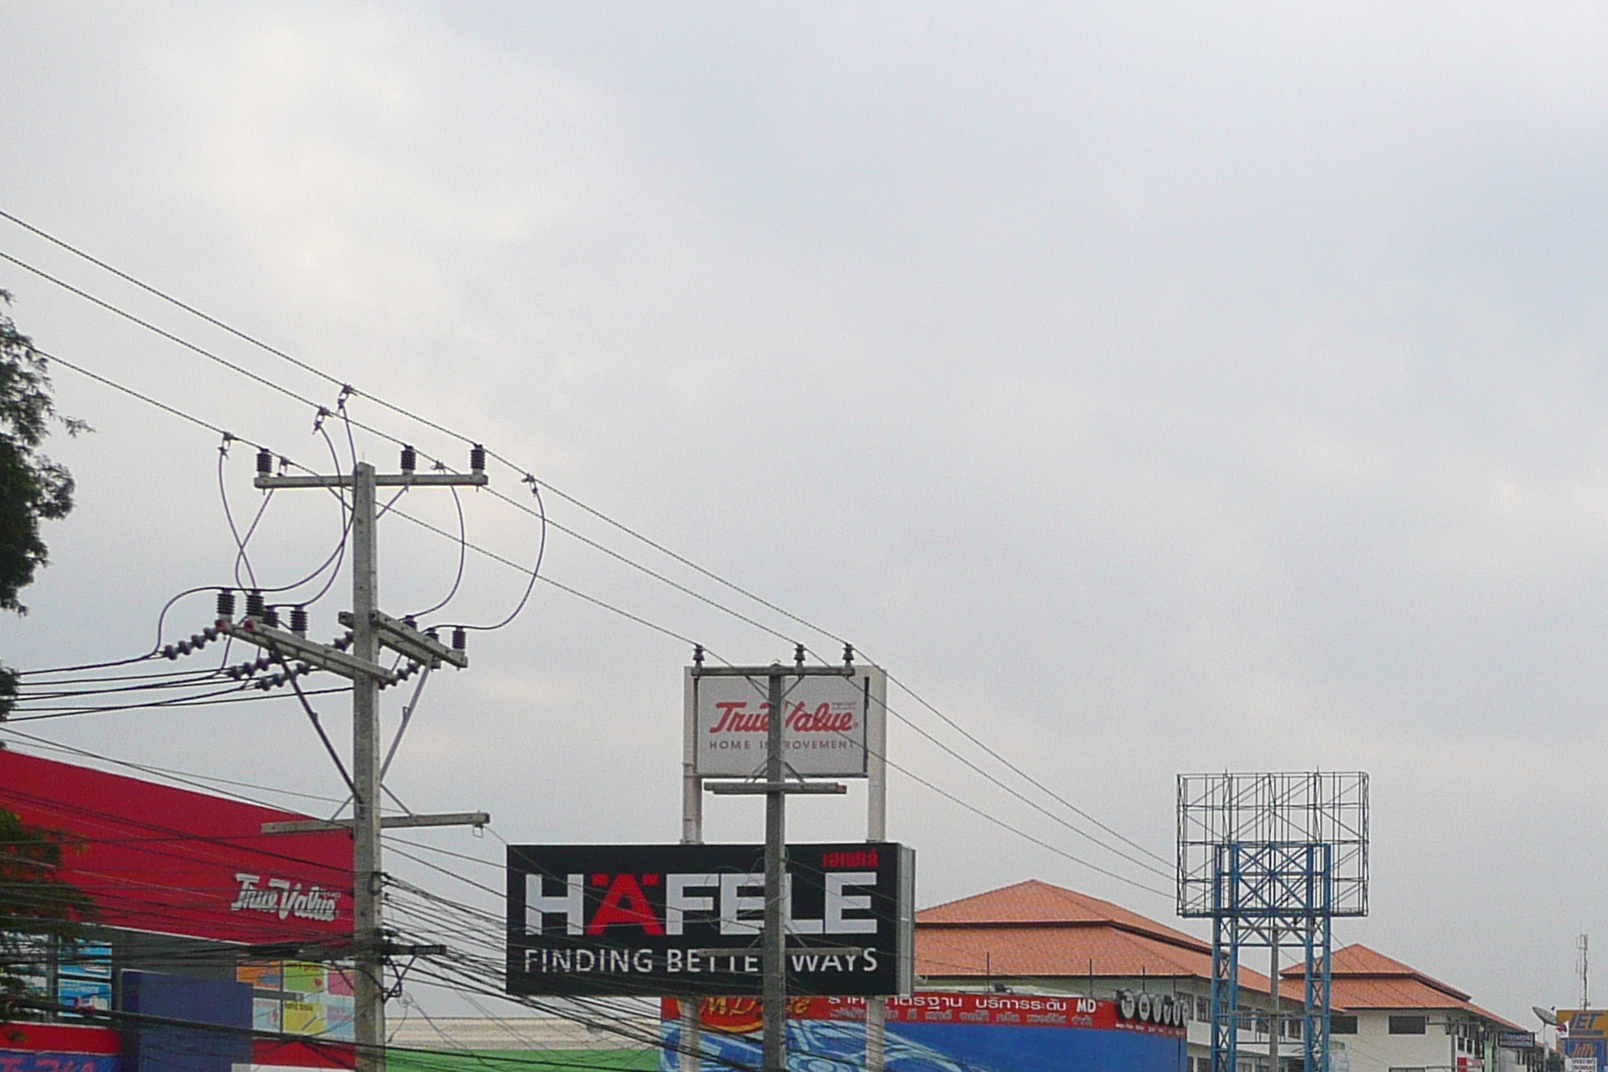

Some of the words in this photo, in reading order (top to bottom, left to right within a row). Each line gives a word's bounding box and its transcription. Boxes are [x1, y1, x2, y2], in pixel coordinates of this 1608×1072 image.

[709, 702, 769, 733] True
[709, 740, 750, 750] HOME
[231, 873, 279, 911] True
[269, 878, 337, 921] Value
[525, 872, 878, 936] HÄFELE
[525, 949, 653, 973] FINDING
[791, 947, 878, 972] WAYS
[1076, 999, 1097, 1013] MD
